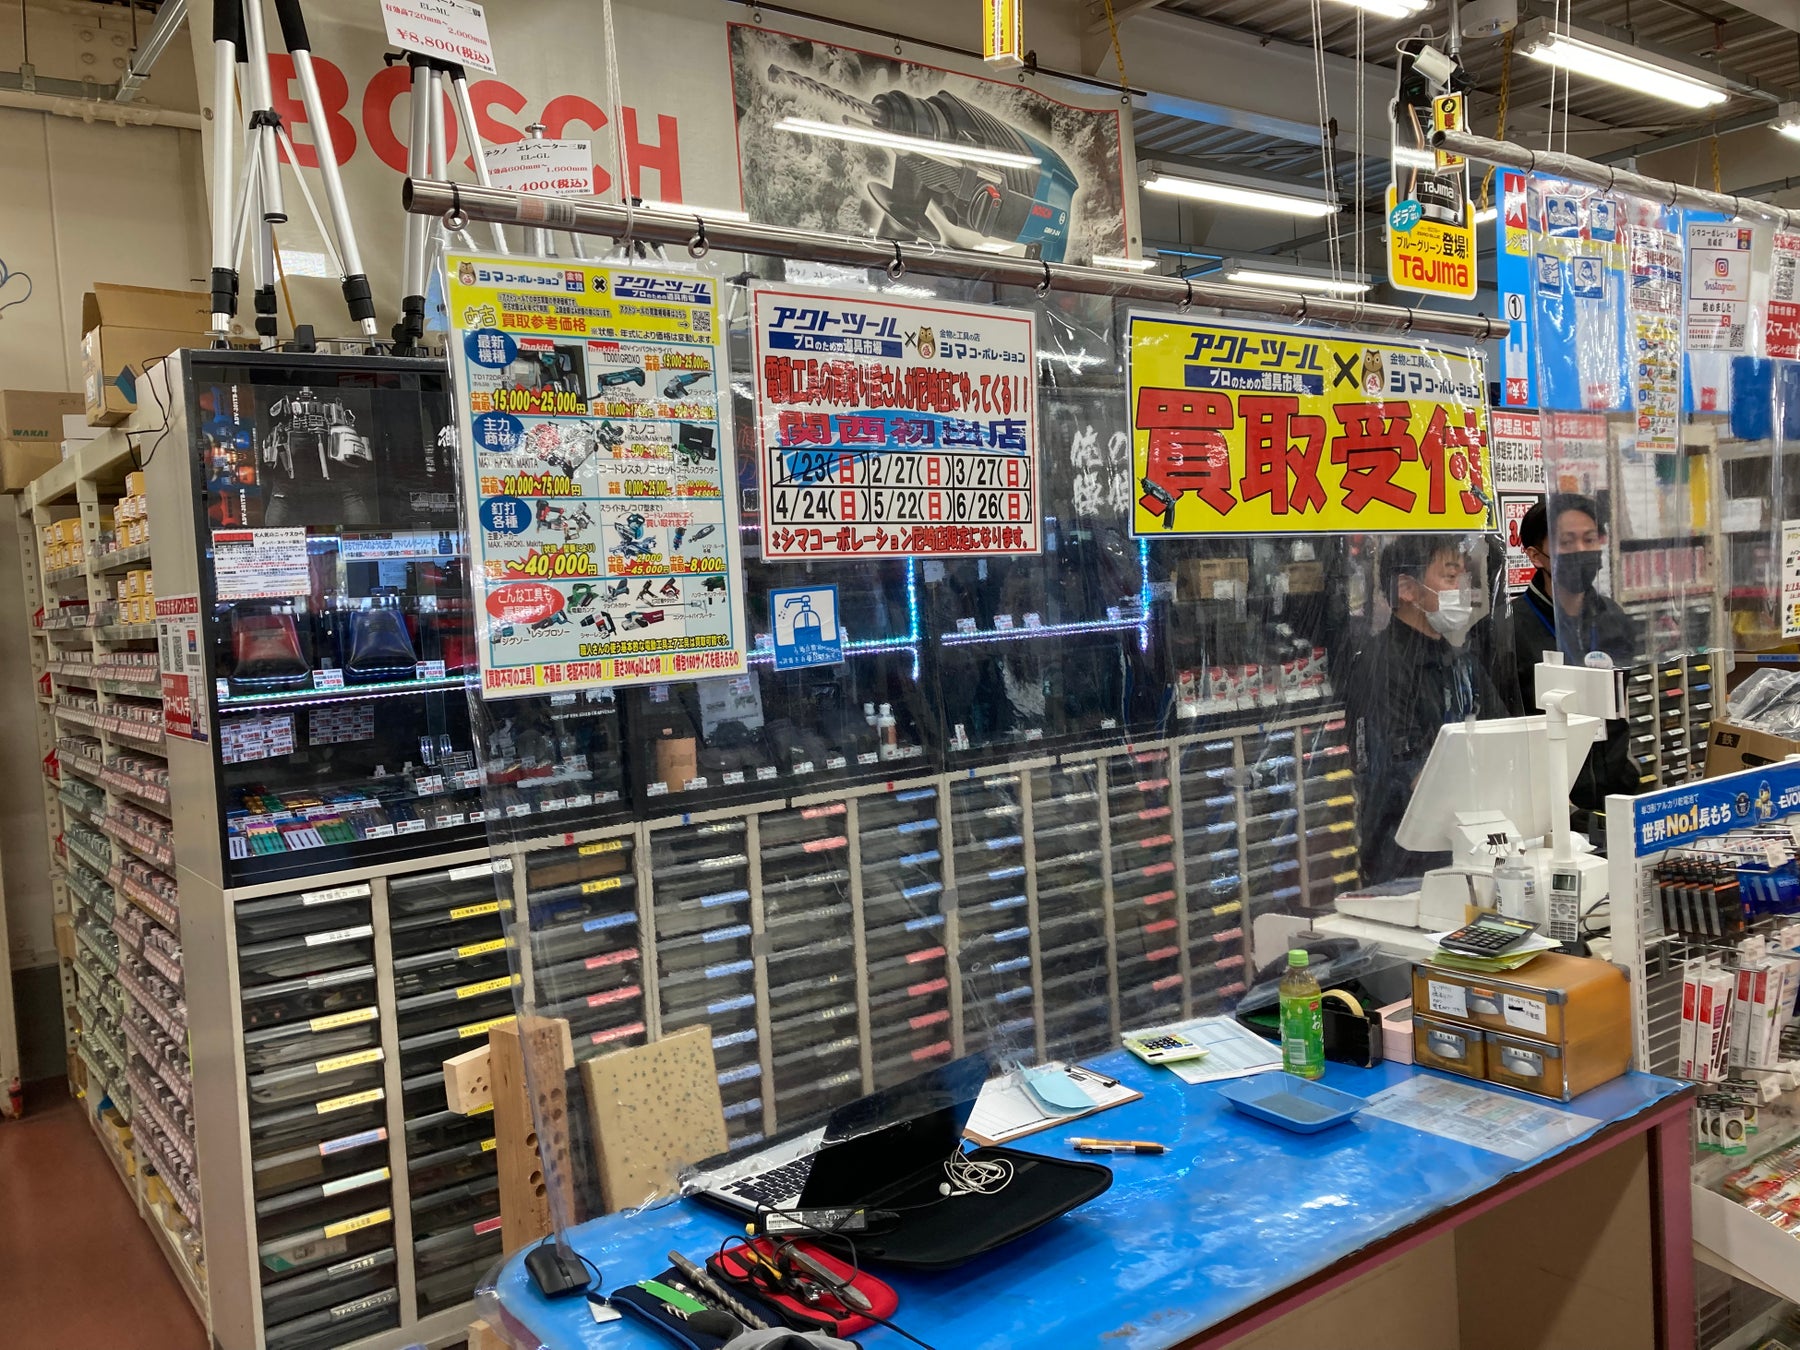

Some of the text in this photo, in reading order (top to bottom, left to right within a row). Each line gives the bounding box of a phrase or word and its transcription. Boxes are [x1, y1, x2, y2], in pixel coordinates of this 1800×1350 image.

[268, 53, 683, 205] BOSCH
[615, 276, 710, 294] アクトツール
[1704, 281, 1737, 294] Instagram
[502, 313, 586, 332] 買取参考価格
[769, 306, 902, 338] アクトツール
[477, 335, 504, 349] 最新
[939, 329, 980, 342] 金物と工具の店
[794, 335, 882, 355] プロのための道具市場
[1184, 333, 1324, 370] アクトツール
[479, 349, 506, 363] 機種
[1210, 368, 1303, 392] プロのための道具市場
[483, 418, 510, 431] 主力
[629, 424, 656, 434] 丸ノコ
[778, 410, 1027, 450] 関西初出店
[12, 429, 48, 437] WAKAI
[1136, 386, 1487, 517] 買取受付
[491, 502, 516, 515] 釘打
[493, 515, 518, 528] 各種
[498, 588, 553, 603] こんな工具も
[502, 637, 530, 646] ジグソー
[1641, 793, 1699, 815] 単3形アルカリ乾電池で
[1642, 803, 1731, 845] 世界No.1長もち
